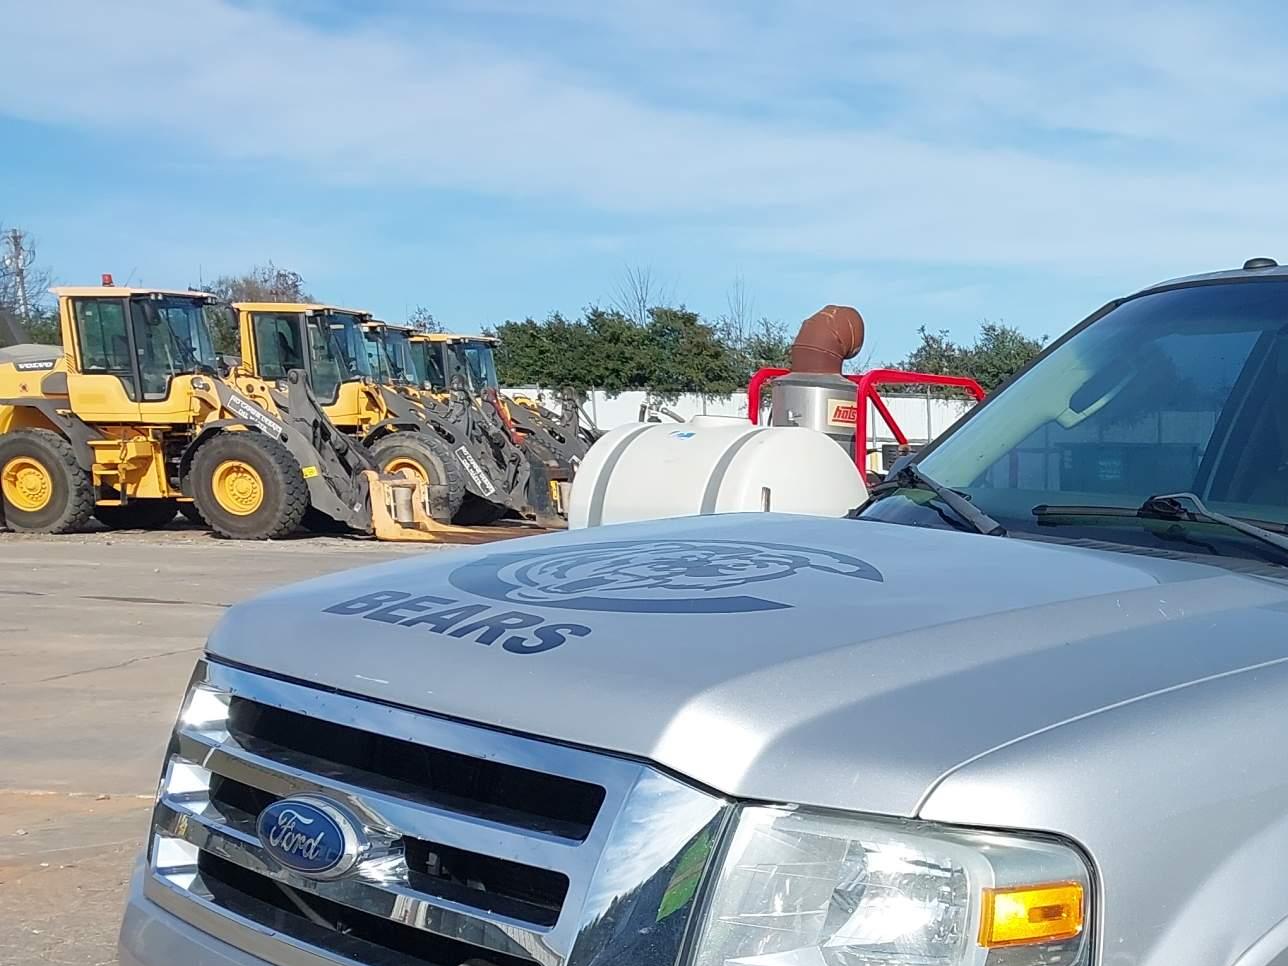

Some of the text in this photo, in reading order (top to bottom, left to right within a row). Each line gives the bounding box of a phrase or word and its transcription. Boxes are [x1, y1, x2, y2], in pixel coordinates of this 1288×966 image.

[18, 361, 54, 369] VOLVO
[833, 405, 857, 420] hots
[322, 590, 592, 655] BEARS
[269, 809, 325, 860] Ford
